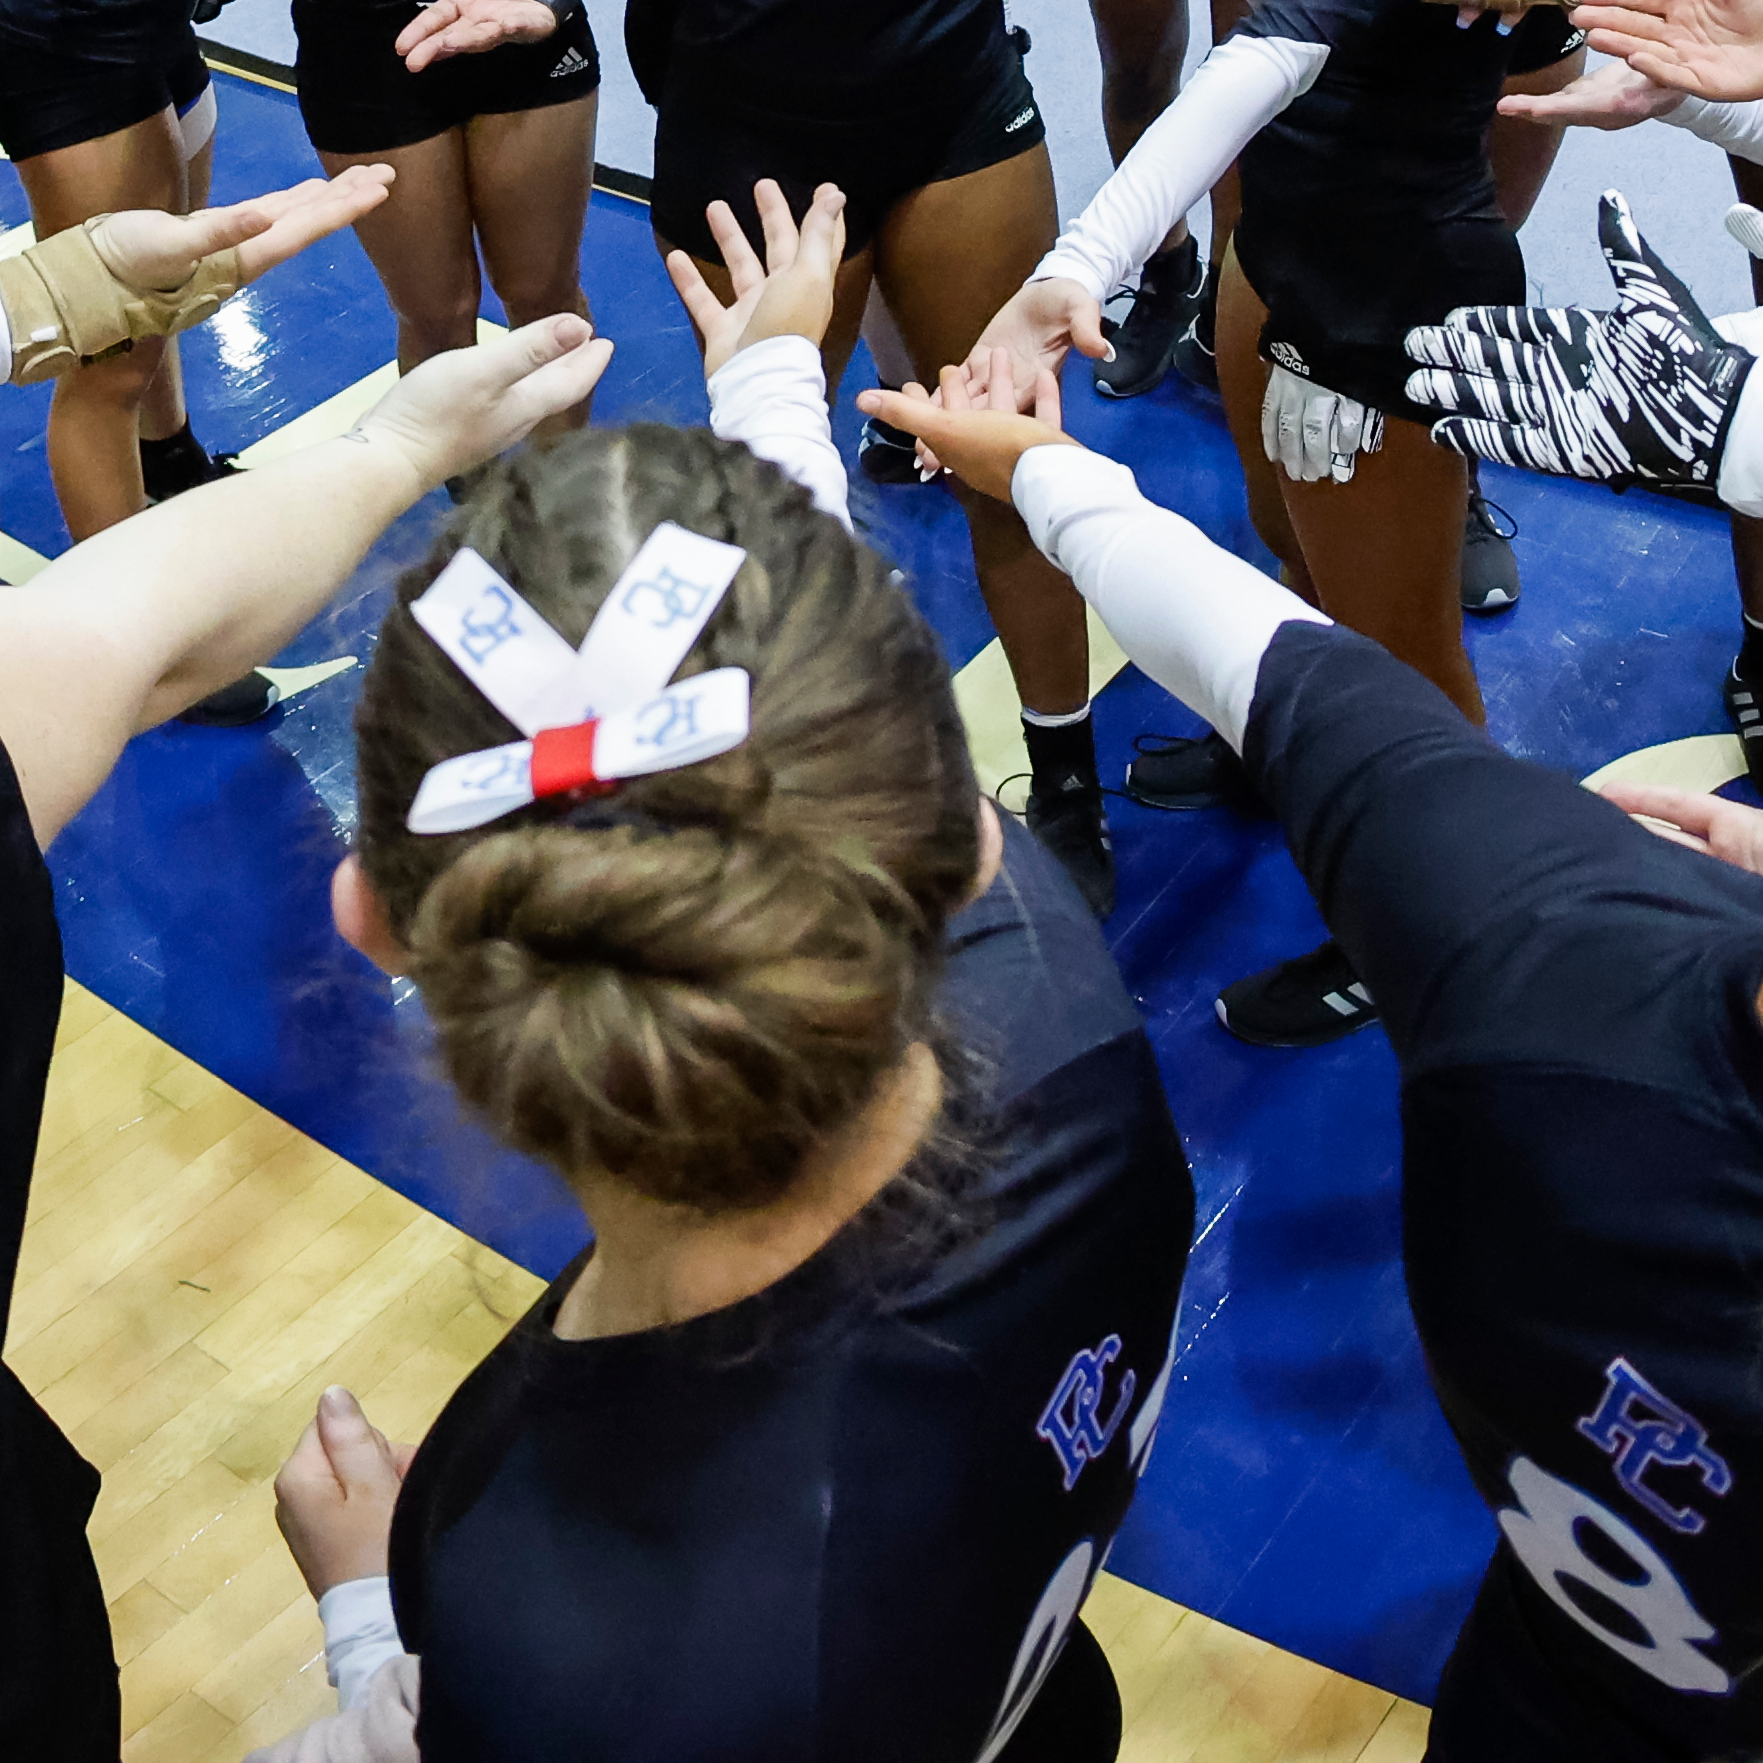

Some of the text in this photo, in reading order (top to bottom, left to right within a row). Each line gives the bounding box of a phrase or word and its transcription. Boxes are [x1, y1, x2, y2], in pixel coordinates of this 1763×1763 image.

[1005, 106, 1034, 133] adidas
[1270, 342, 1311, 376] adidas
[1574, 1355, 1734, 1535] PC
